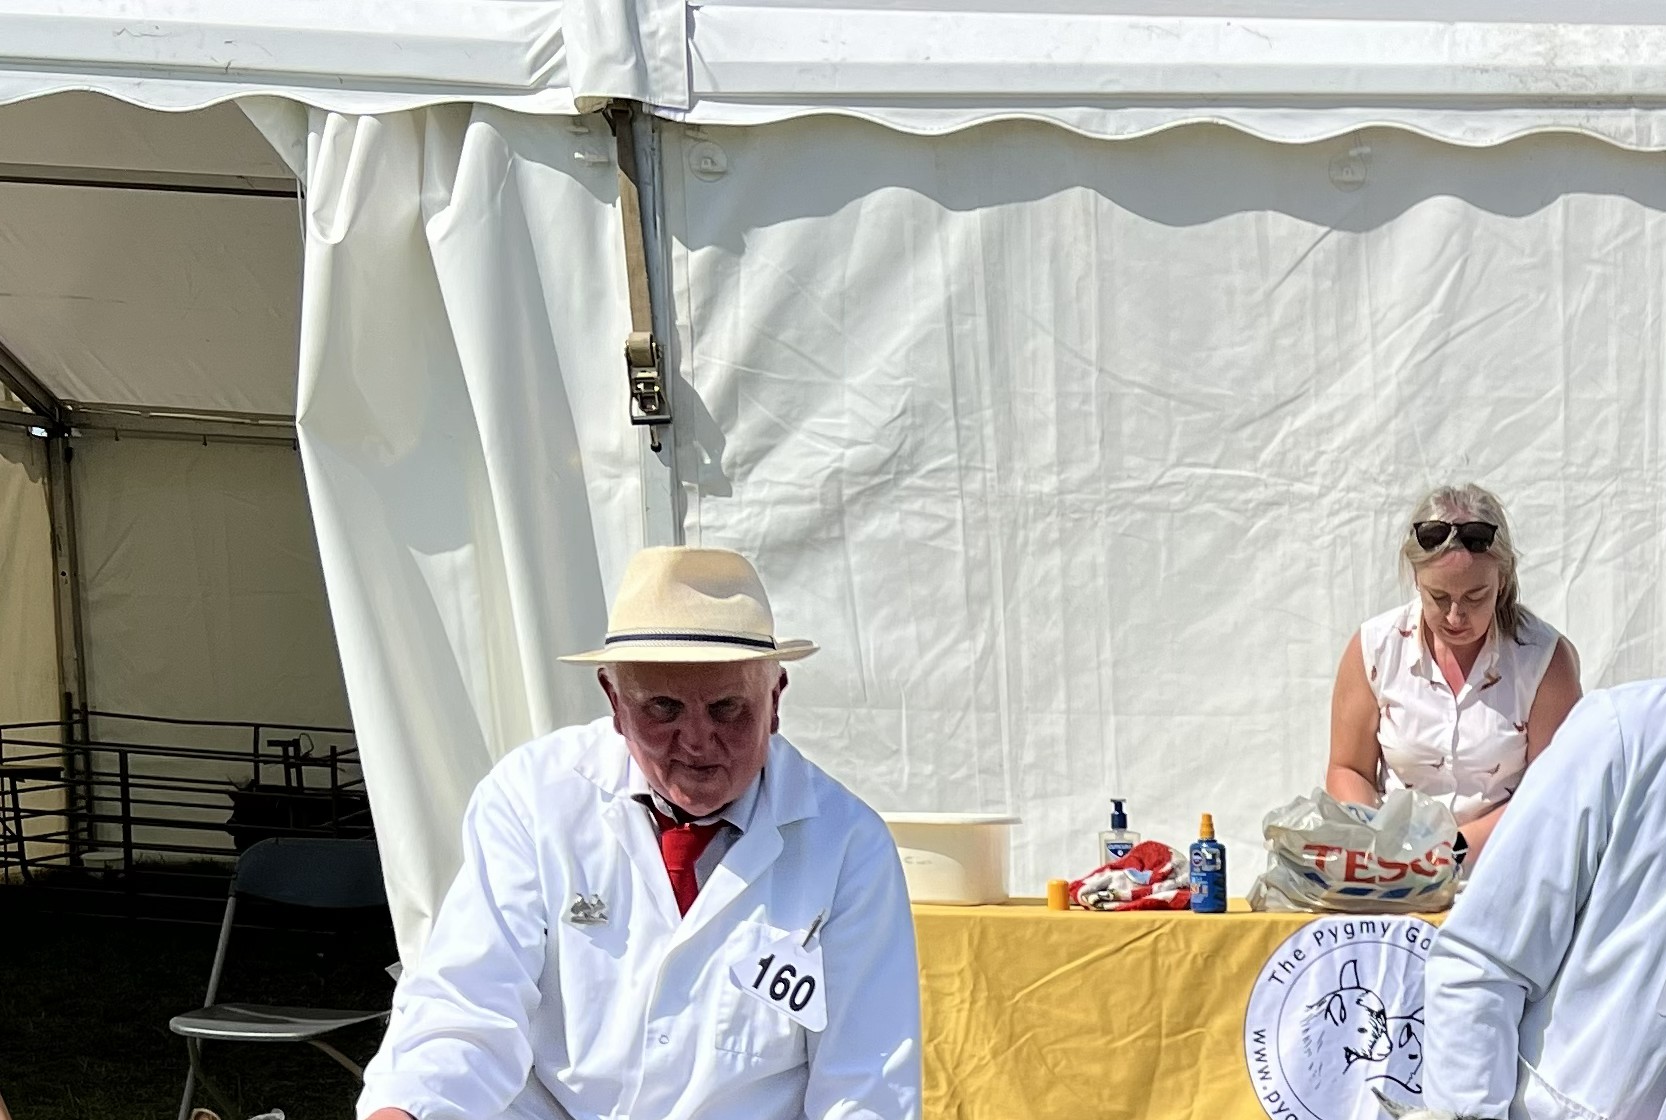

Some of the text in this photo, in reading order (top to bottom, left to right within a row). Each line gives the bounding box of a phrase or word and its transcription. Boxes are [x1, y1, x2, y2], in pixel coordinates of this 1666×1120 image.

[752, 953, 816, 1012] 160
[1268, 948, 1306, 986] The
[1313, 919, 1392, 946] Pygmy
